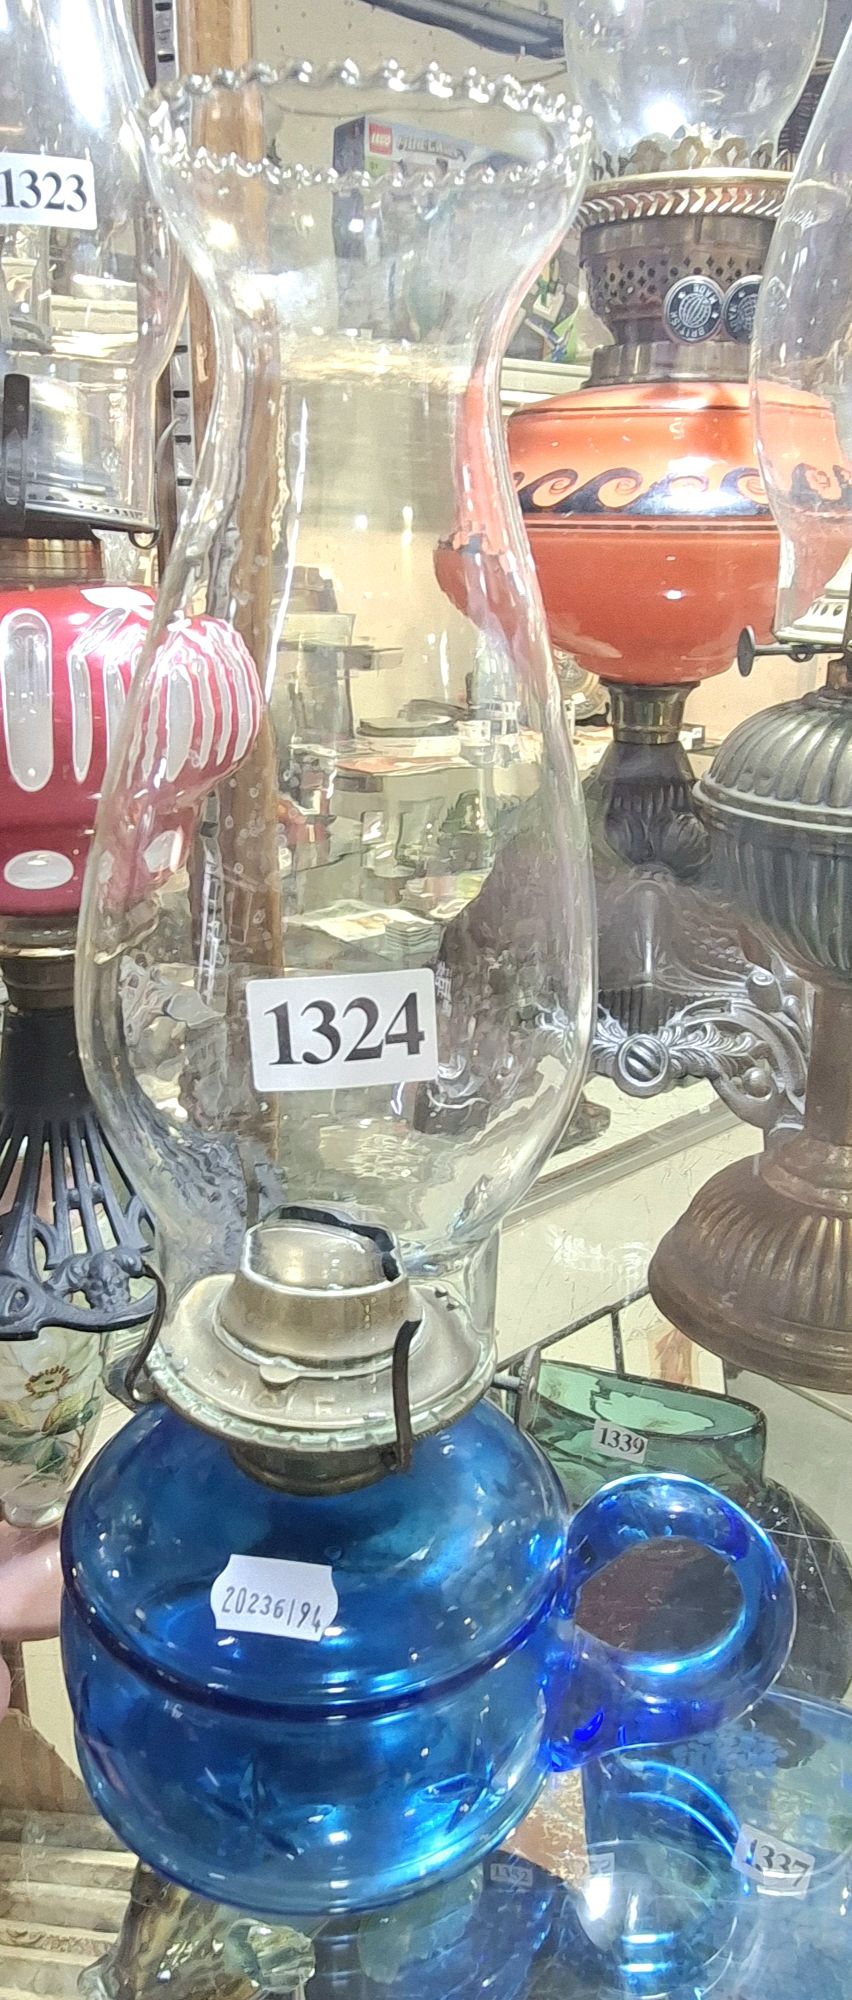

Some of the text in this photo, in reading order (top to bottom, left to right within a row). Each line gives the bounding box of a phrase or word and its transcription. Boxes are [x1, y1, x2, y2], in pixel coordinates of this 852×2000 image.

[0, 168, 87, 212] 1323
[693, 283, 718, 305] MADE
[669, 311, 706, 339] BRITISH
[264, 992, 425, 1065] 1324
[599, 1427, 645, 1454] 1339
[743, 1839, 810, 1888] 1337
